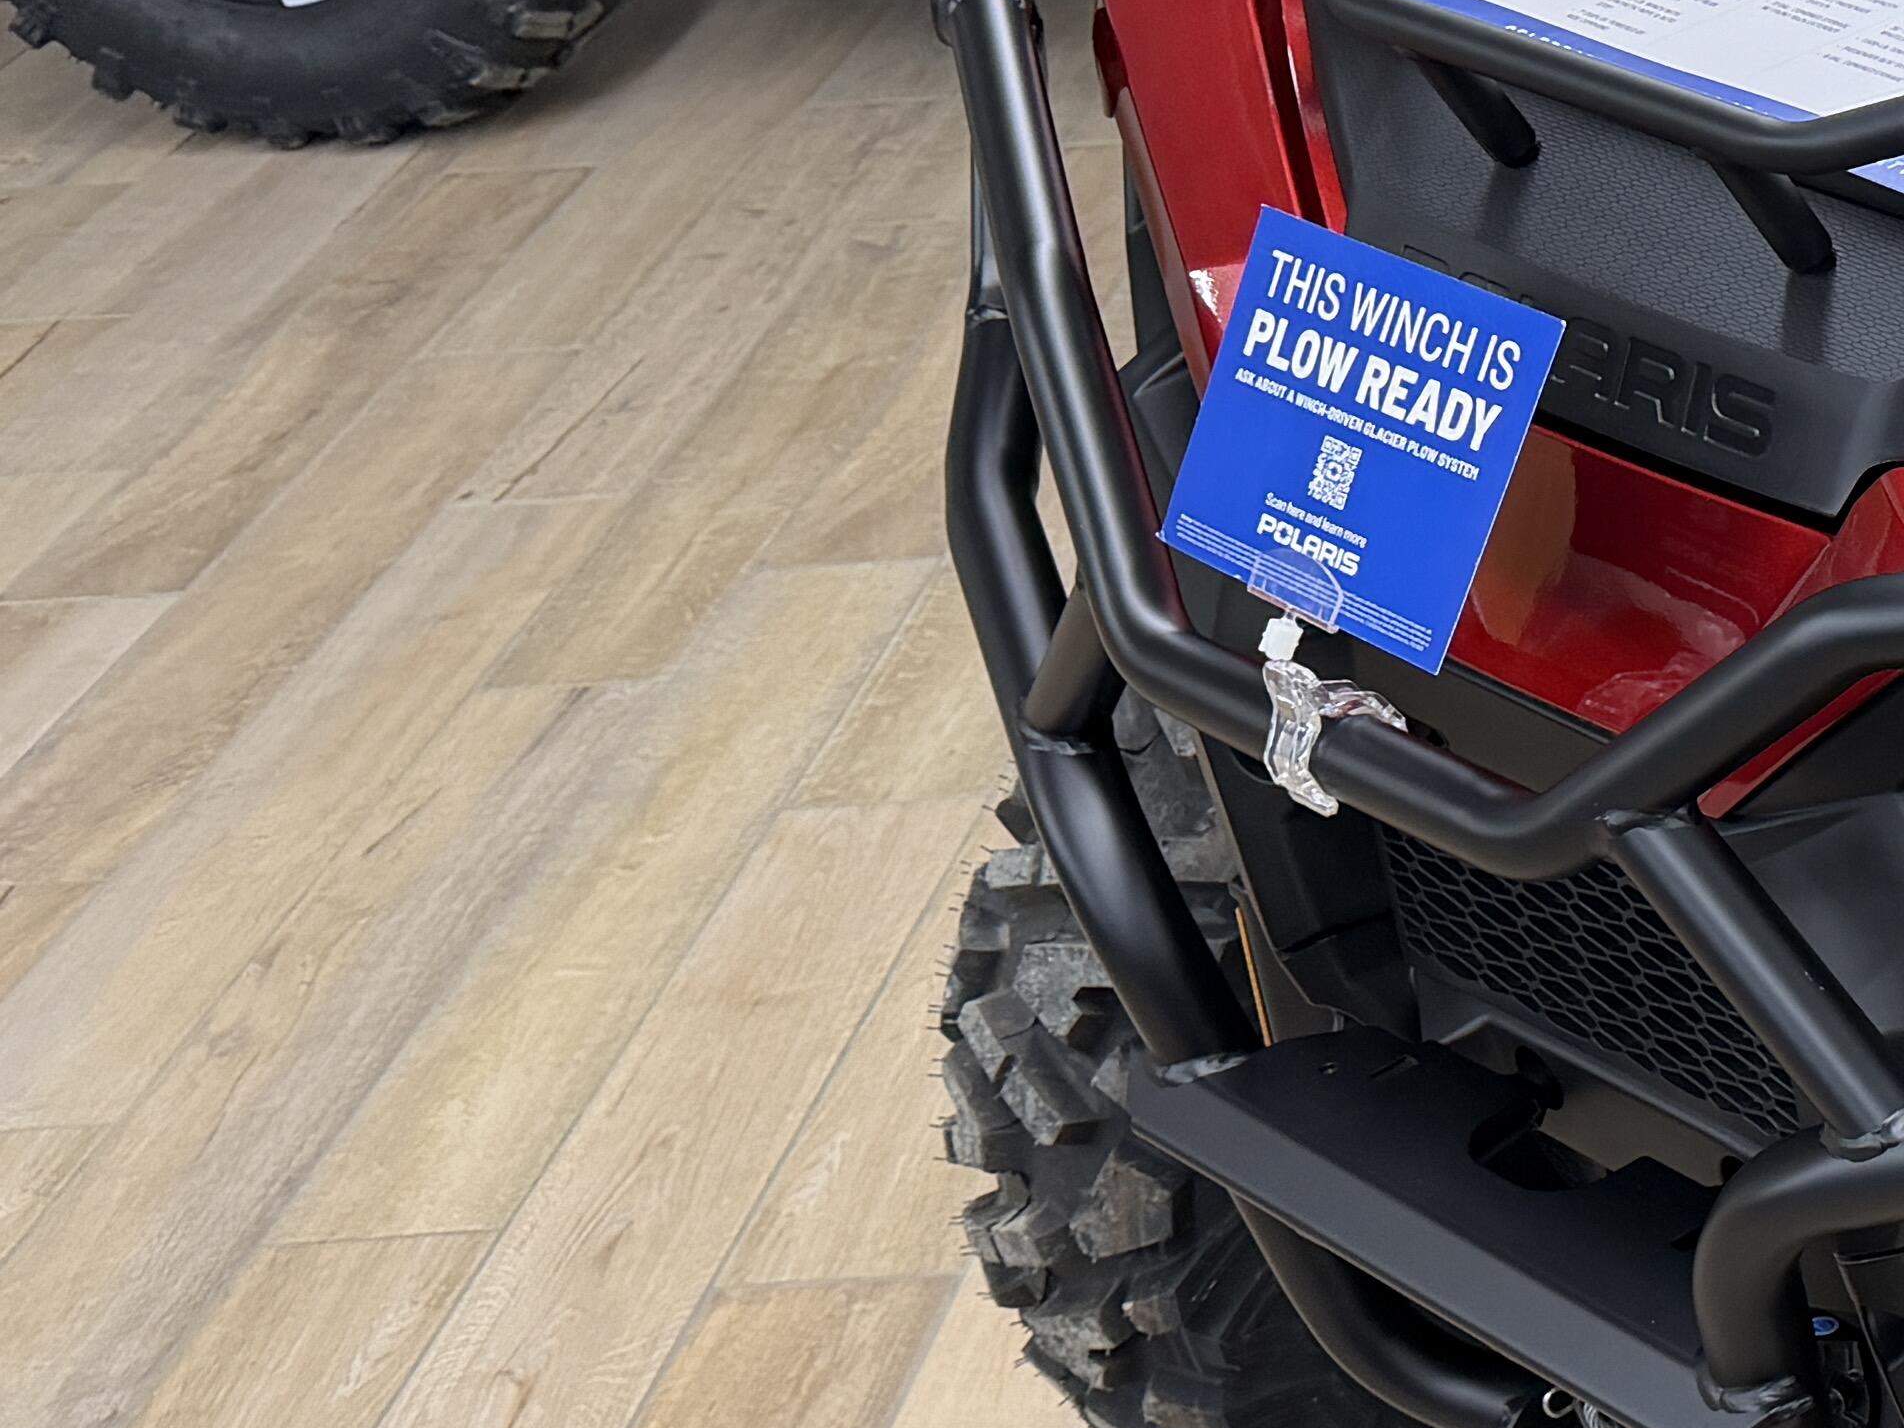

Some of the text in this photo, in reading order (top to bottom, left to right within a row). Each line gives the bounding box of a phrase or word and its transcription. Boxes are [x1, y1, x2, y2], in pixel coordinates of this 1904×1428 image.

[1267, 249, 1521, 391] THIS WINCH IS
[1234, 367, 1480, 481] ASK ABOUT A WINCH-DRIVEN GLACIER PLOW SYSTEM
[1242, 308, 1503, 452] PLOW READY
[1256, 513, 1360, 576] POLARIS
[1264, 492, 1368, 548] Scan here and learn more
